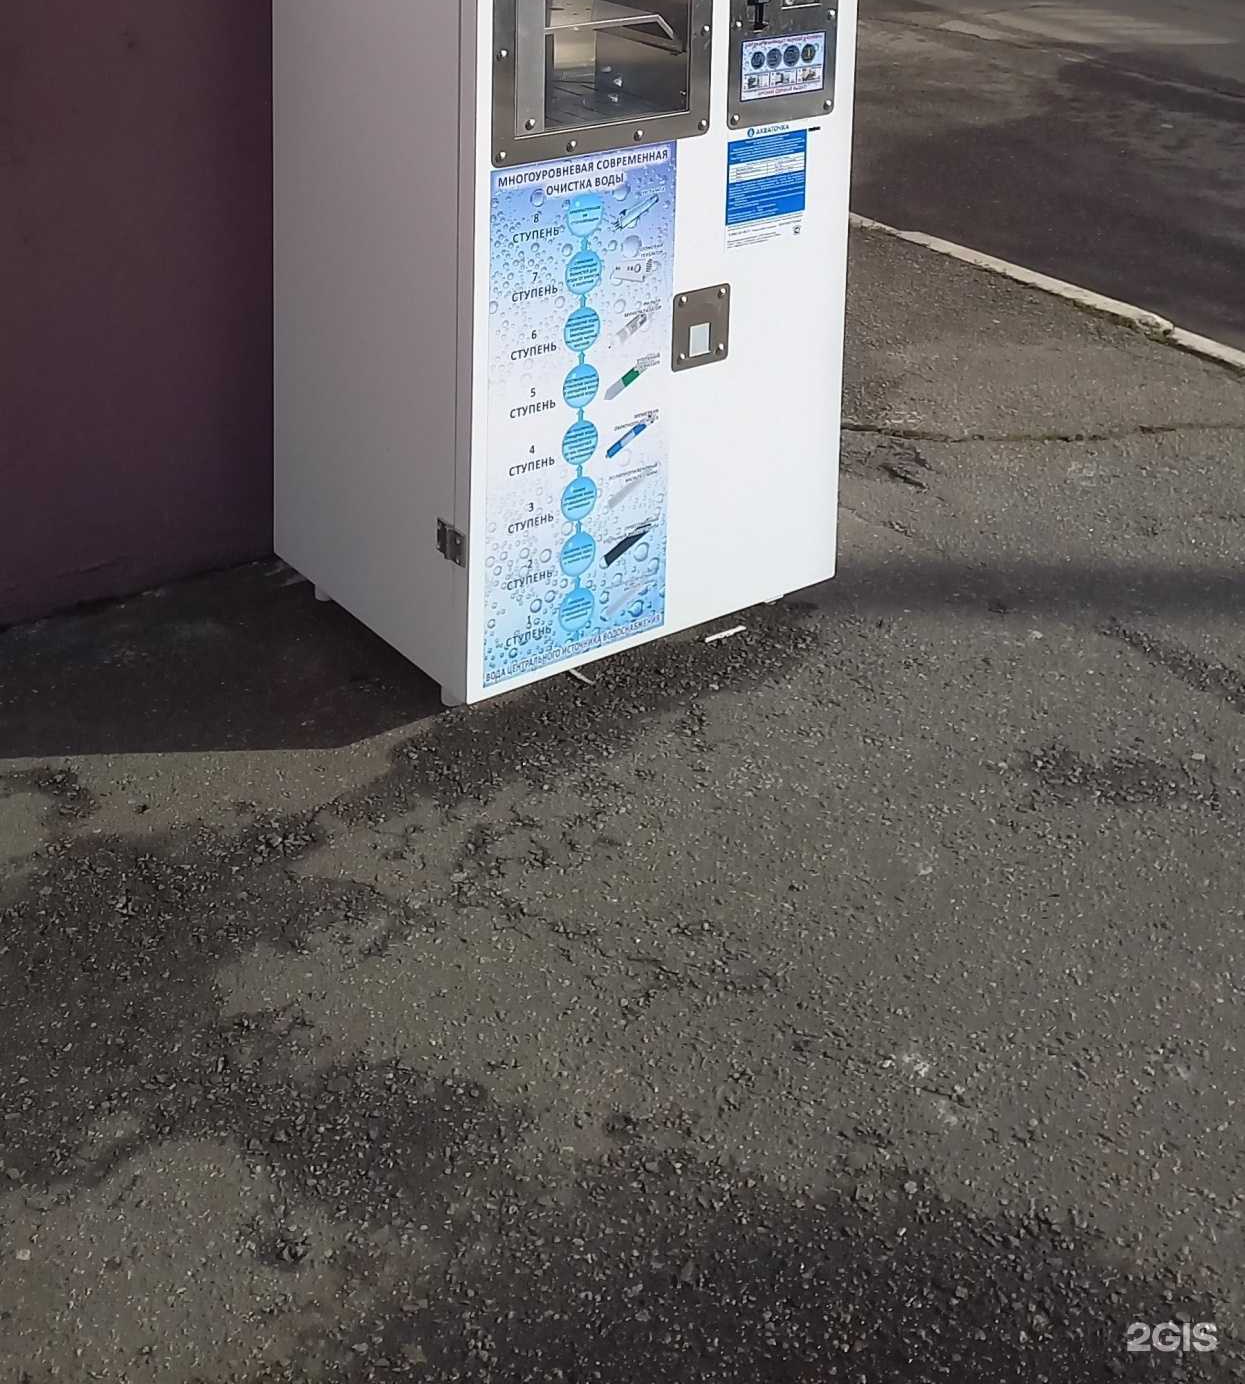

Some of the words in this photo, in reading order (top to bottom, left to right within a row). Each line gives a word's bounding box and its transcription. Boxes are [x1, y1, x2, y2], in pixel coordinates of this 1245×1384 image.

[498, 161, 594, 187] МНОГОУРОВНЕВАЯ
[596, 149, 668, 170] СОВРЕМЕННАЯ
[546, 180, 593, 196] ОЧИСТКА
[594, 173, 624, 188] ВОДЫ
[533, 212, 540, 224] 8
[512, 226, 560, 244] СТУПЕНЬ
[532, 271, 538, 282] 7
[511, 285, 559, 303] СТУПЕНЬ
[531, 329, 537, 340] 6
[510, 343, 557, 361] СТУПЕНЬ
[530, 387, 536, 398] 5
[509, 399, 556, 419] СТУПЕНЬ
[529, 444, 535, 455] 4
[508, 456, 555, 477] СТУПЕНЬ
[528, 502, 534, 513] 3
[507, 513, 554, 534] СТУПЕНЬ
[506, 571, 553, 591] СТУПЕНЬ
[505, 626, 552, 648] СТУПЕНЬ
[485, 667, 507, 682] ВОДА
